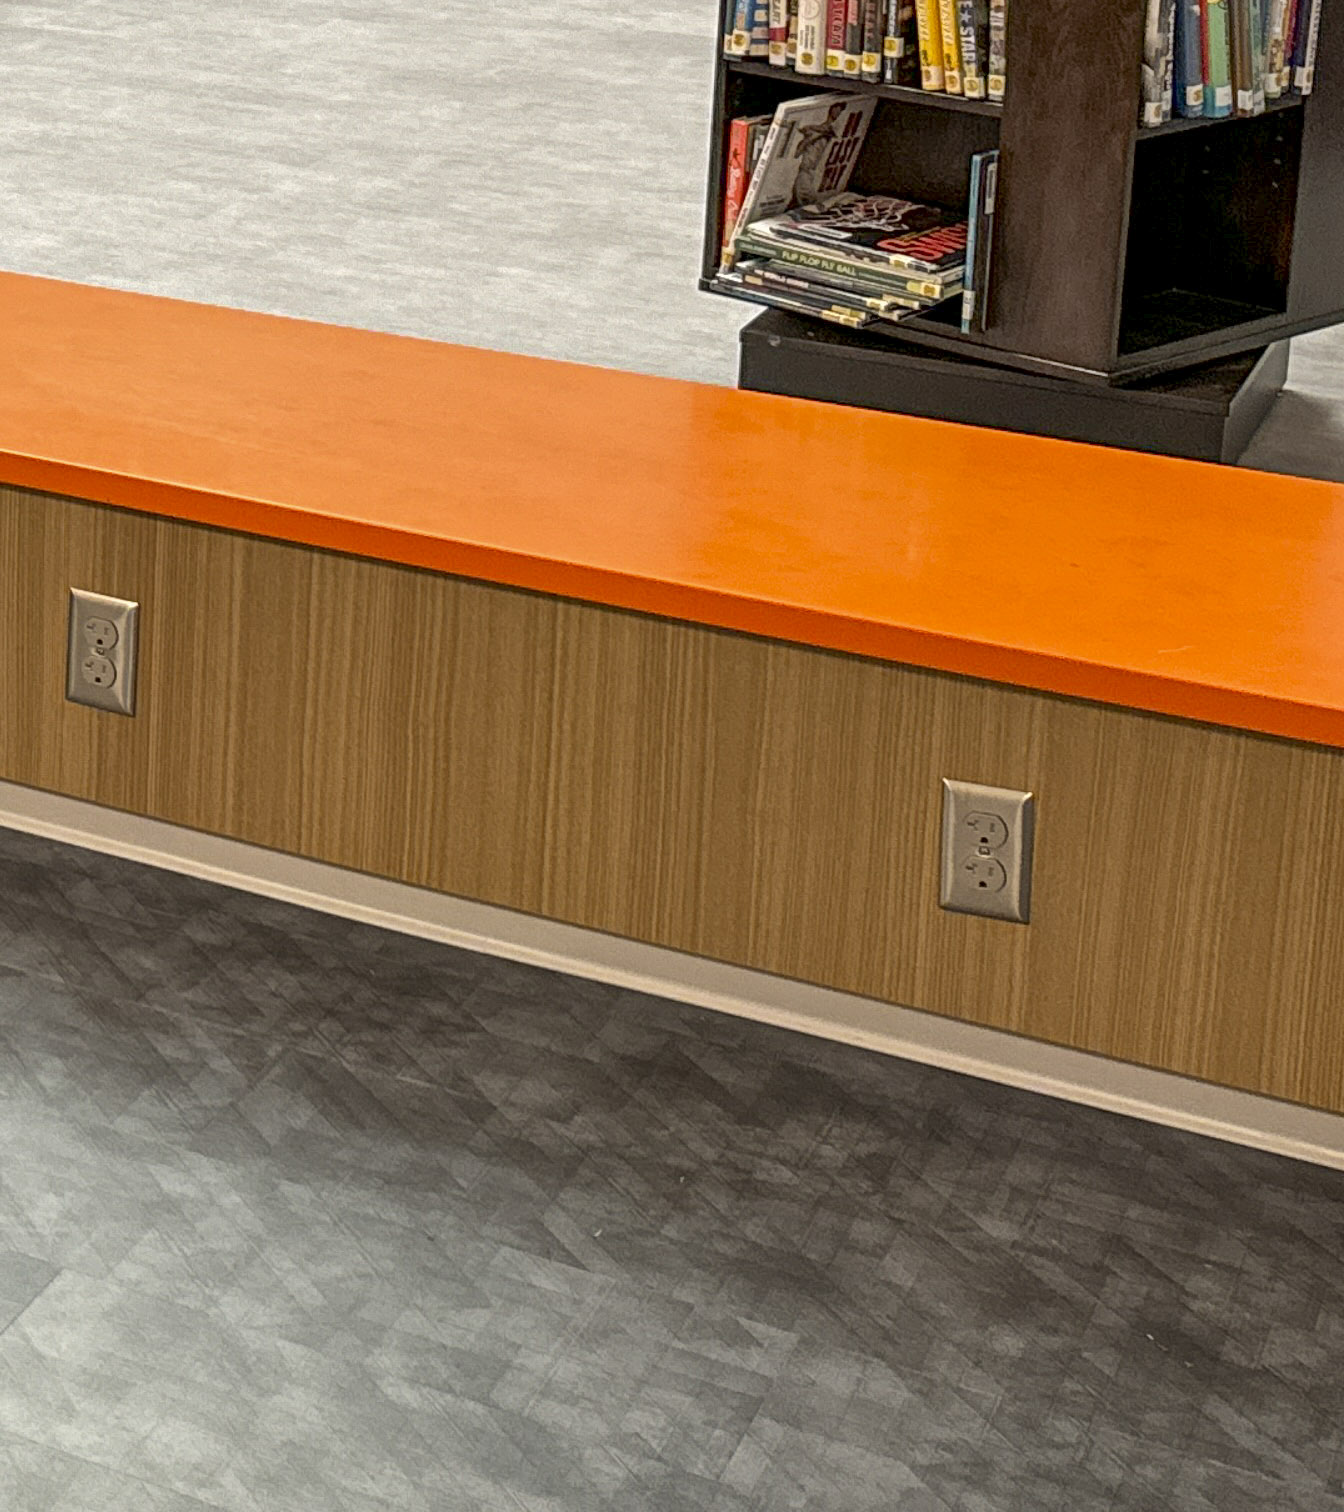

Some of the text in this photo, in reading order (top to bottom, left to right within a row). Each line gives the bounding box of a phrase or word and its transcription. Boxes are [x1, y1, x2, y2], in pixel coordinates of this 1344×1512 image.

[959, 25, 976, 63] STAR
[782, 250, 857, 278] FLIP FLOP FLY BALL
